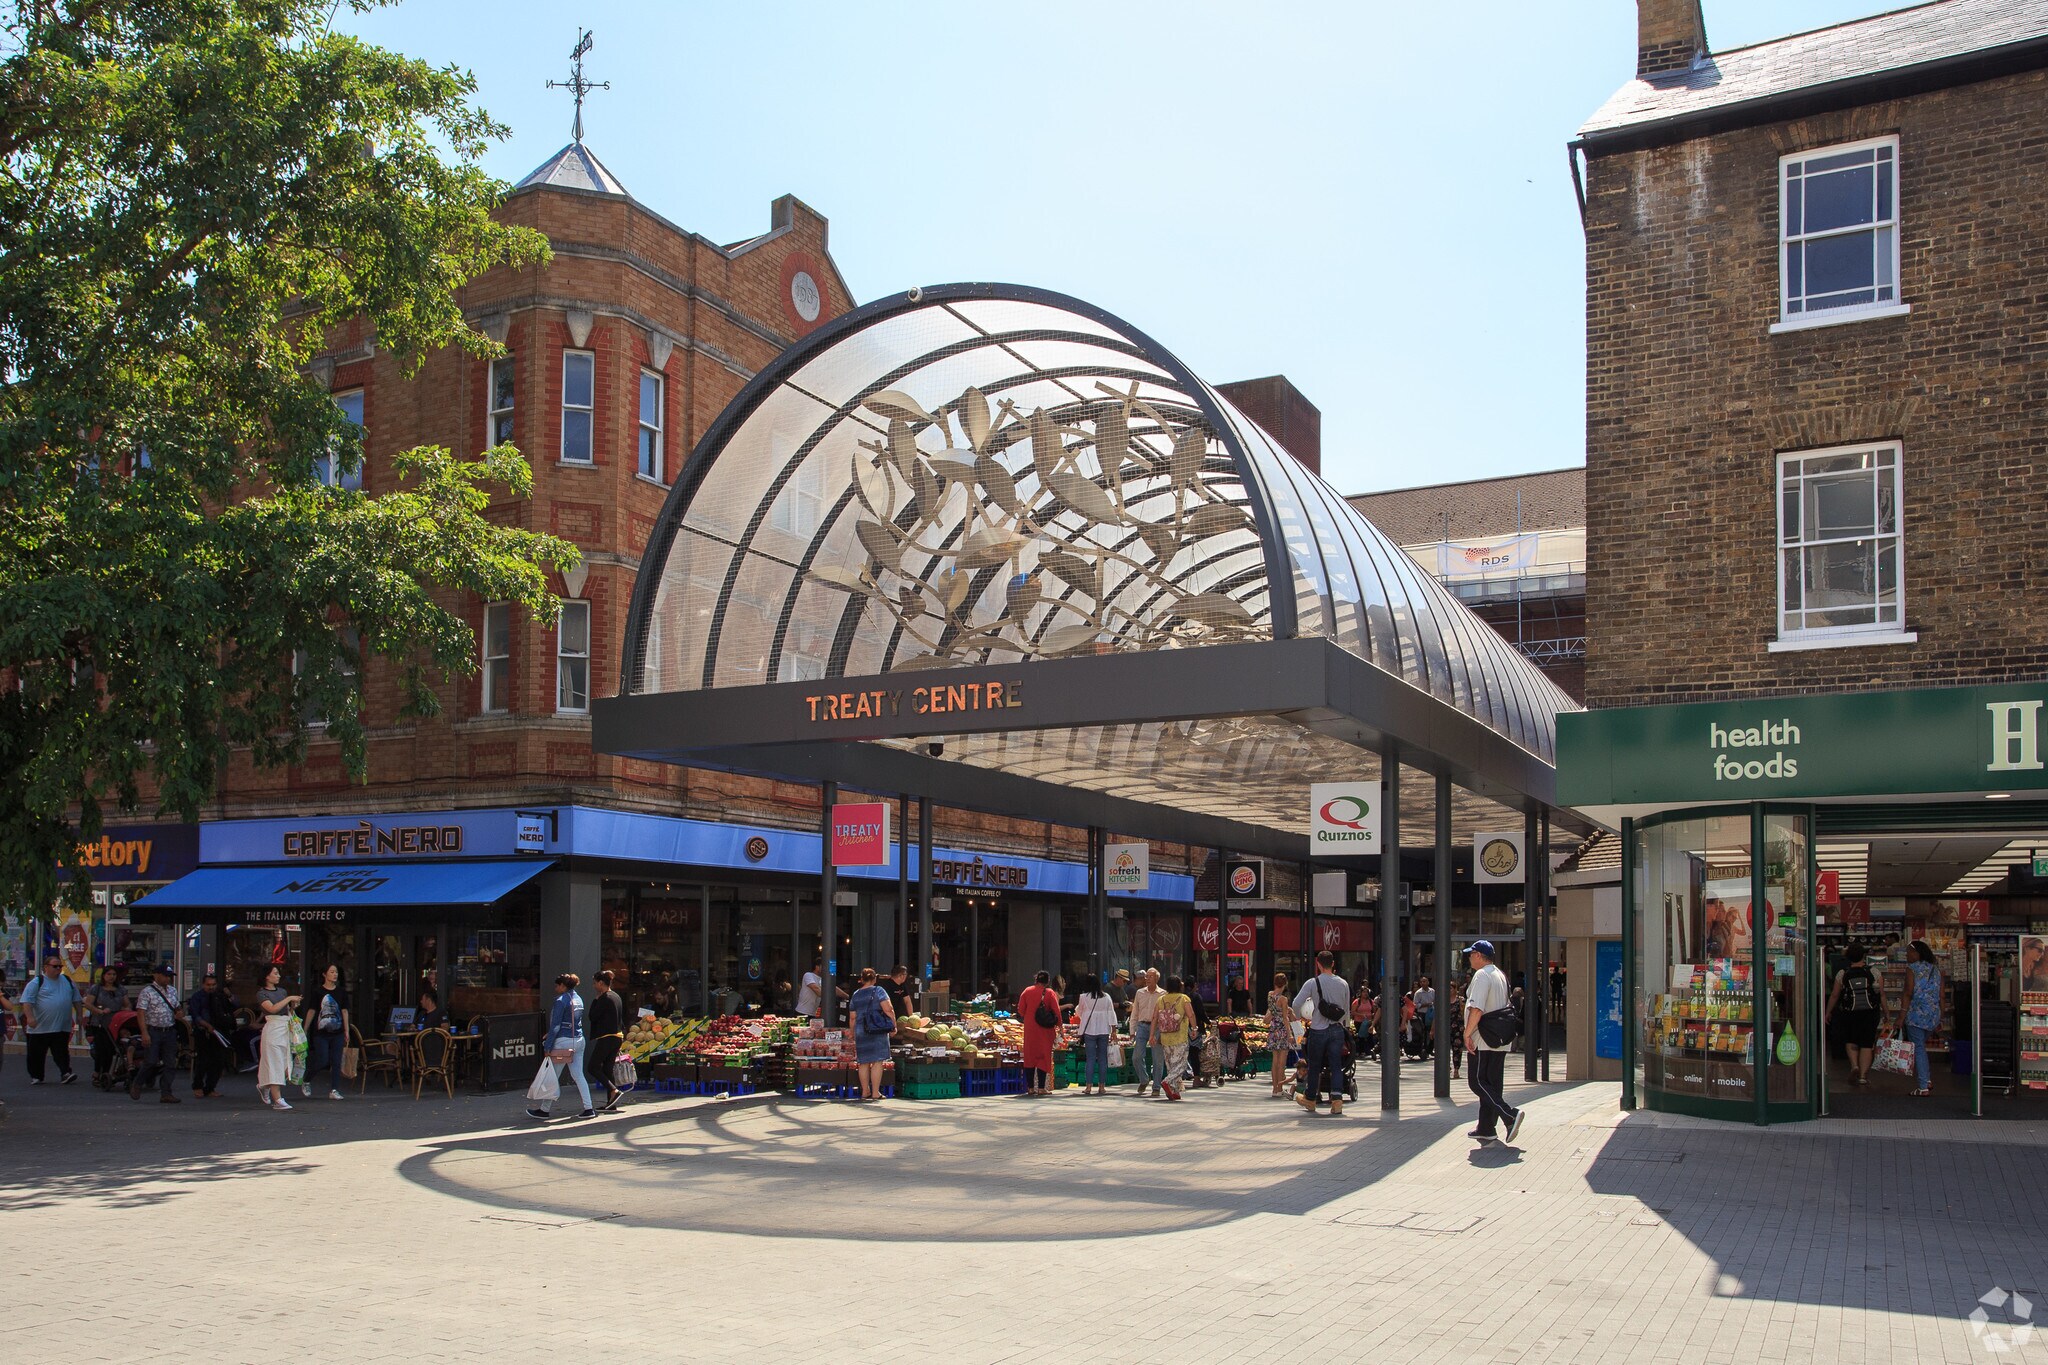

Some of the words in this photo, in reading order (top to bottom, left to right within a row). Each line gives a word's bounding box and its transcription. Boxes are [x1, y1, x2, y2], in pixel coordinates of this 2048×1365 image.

[1481, 555, 1510, 565] RDS
[805, 690, 903, 721] TREATY
[912, 680, 1023, 714] CENTRE
[1711, 719, 1800, 748] health
[1986, 700, 2044, 771] H
[1714, 752, 1798, 780] foods
[835, 824, 881, 837] TREATY
[1317, 830, 1372, 842] Quiznos
[376, 825, 463, 854] NERO
[519, 833, 544, 842] NERO
[838, 834, 875, 847] Kitchen
[984, 864, 1028, 887] NERO
[1109, 866, 1140, 875] sofresh
[1708, 867, 1737, 880] HOLLAND
[273, 878, 390, 894] NERO
[1235, 876, 1253, 886] KING
[246, 911, 261, 920] THE
[264, 911, 296, 920] ITALIAN
[300, 911, 331, 920] COFFEE
[492, 1044, 535, 1060] NERO
[1781, 1041, 1796, 1051] CBD
[1684, 1075, 1702, 1083] online
[1717, 1078, 1746, 1087] mobile
